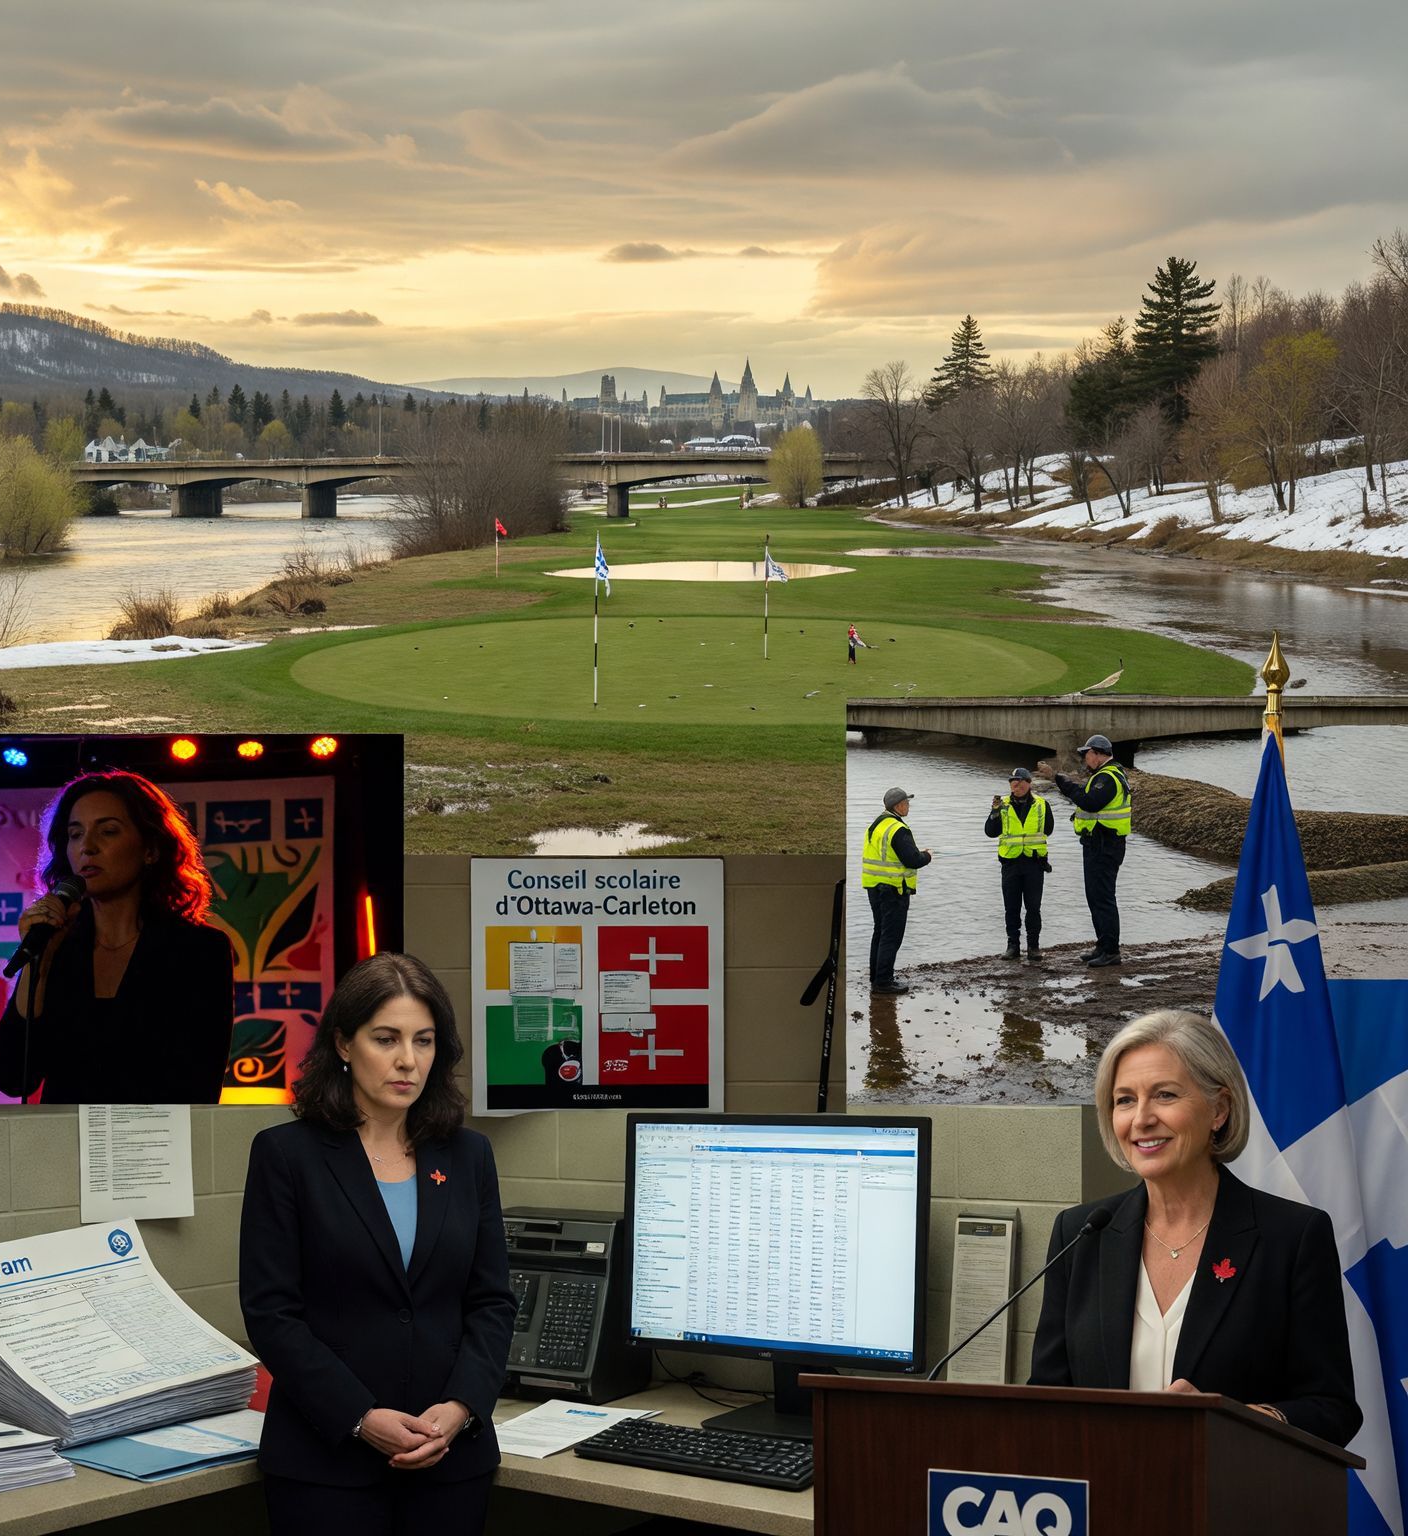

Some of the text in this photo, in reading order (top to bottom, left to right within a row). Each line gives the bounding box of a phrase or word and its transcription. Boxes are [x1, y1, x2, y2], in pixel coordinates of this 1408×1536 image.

[507, 869, 681, 889] Conseil scolaire
[943, 1486, 1073, 1536] CAQ
